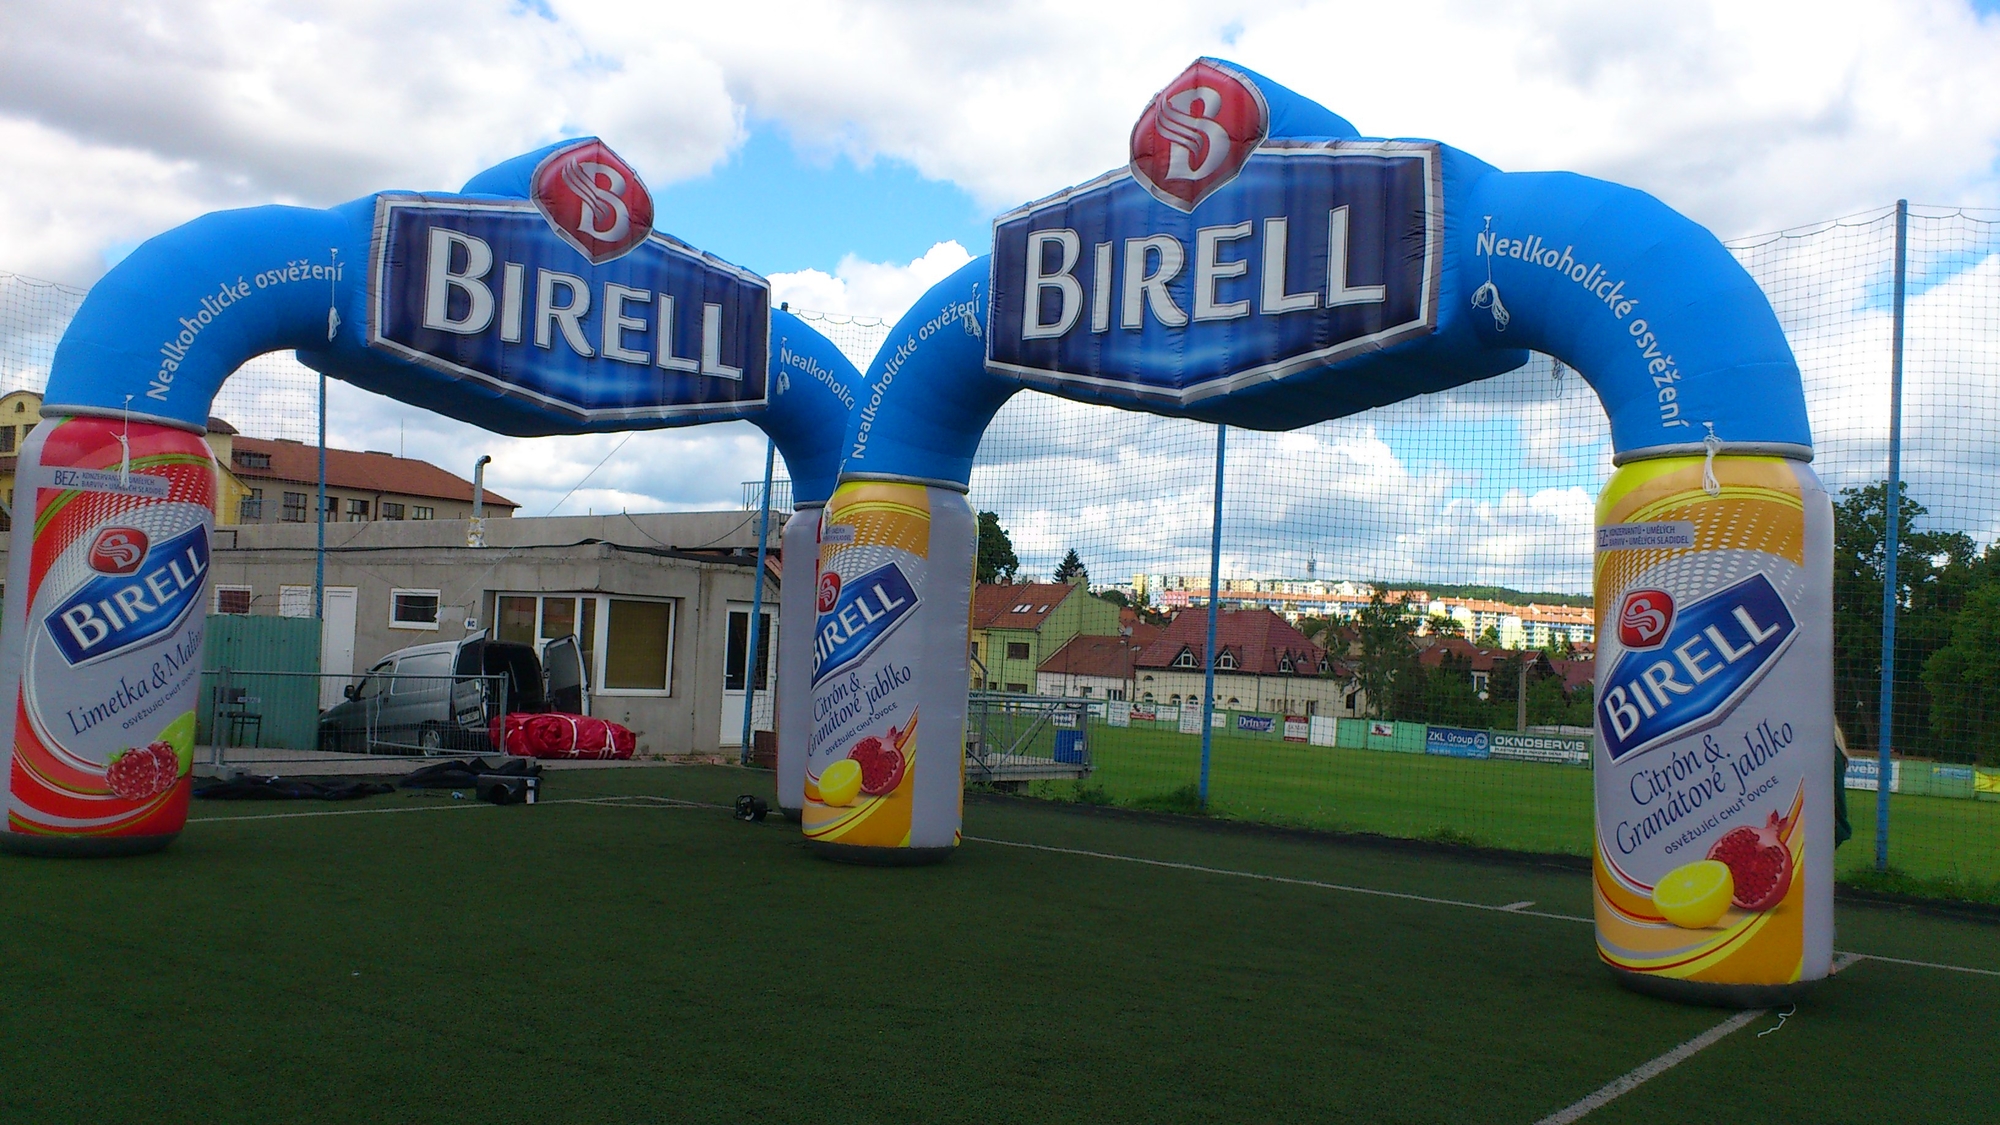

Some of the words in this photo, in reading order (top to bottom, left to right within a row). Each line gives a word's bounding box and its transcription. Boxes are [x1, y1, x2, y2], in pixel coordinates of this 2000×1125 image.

[422, 226, 743, 381] BIRELL
[1021, 204, 1386, 340] BIRELL
[147, 276, 251, 401] Nealkoholické
[255, 259, 345, 289] osvěžení
[1475, 232, 1639, 320] Nealkoholické
[1628, 318, 1690, 428] osvěžení
[780, 347, 855, 411] Nealkoholic
[851, 334, 917, 459] Nealkoholické
[54, 470, 79, 487] BEZ:
[1656, 535, 1689, 544] SLADIDEL
[60, 545, 207, 651] BIRELL
[66, 676, 149, 736] Limetka
[151, 662, 168, 689] &
[814, 684, 848, 722] Citrón
[849, 672, 862, 692] &
[863, 663, 911, 716] jablko
[1604, 604, 1781, 743] BIRELL
[874, 702, 898, 720] OVOCE
[1428, 731, 1445, 742] ZKL
[1447, 732, 1473, 746] Group
[1494, 736, 1585, 751] OKNOSERVIS
[1616, 764, 1726, 855] Granátové
[1727, 718, 1793, 795] jablko
[1630, 751, 1701, 806] Citrón
[1704, 734, 1725, 763] &
[1664, 815, 1719, 855] OSVĚŽUJÍCÍ
[1747, 775, 1780, 802] OVOCE
